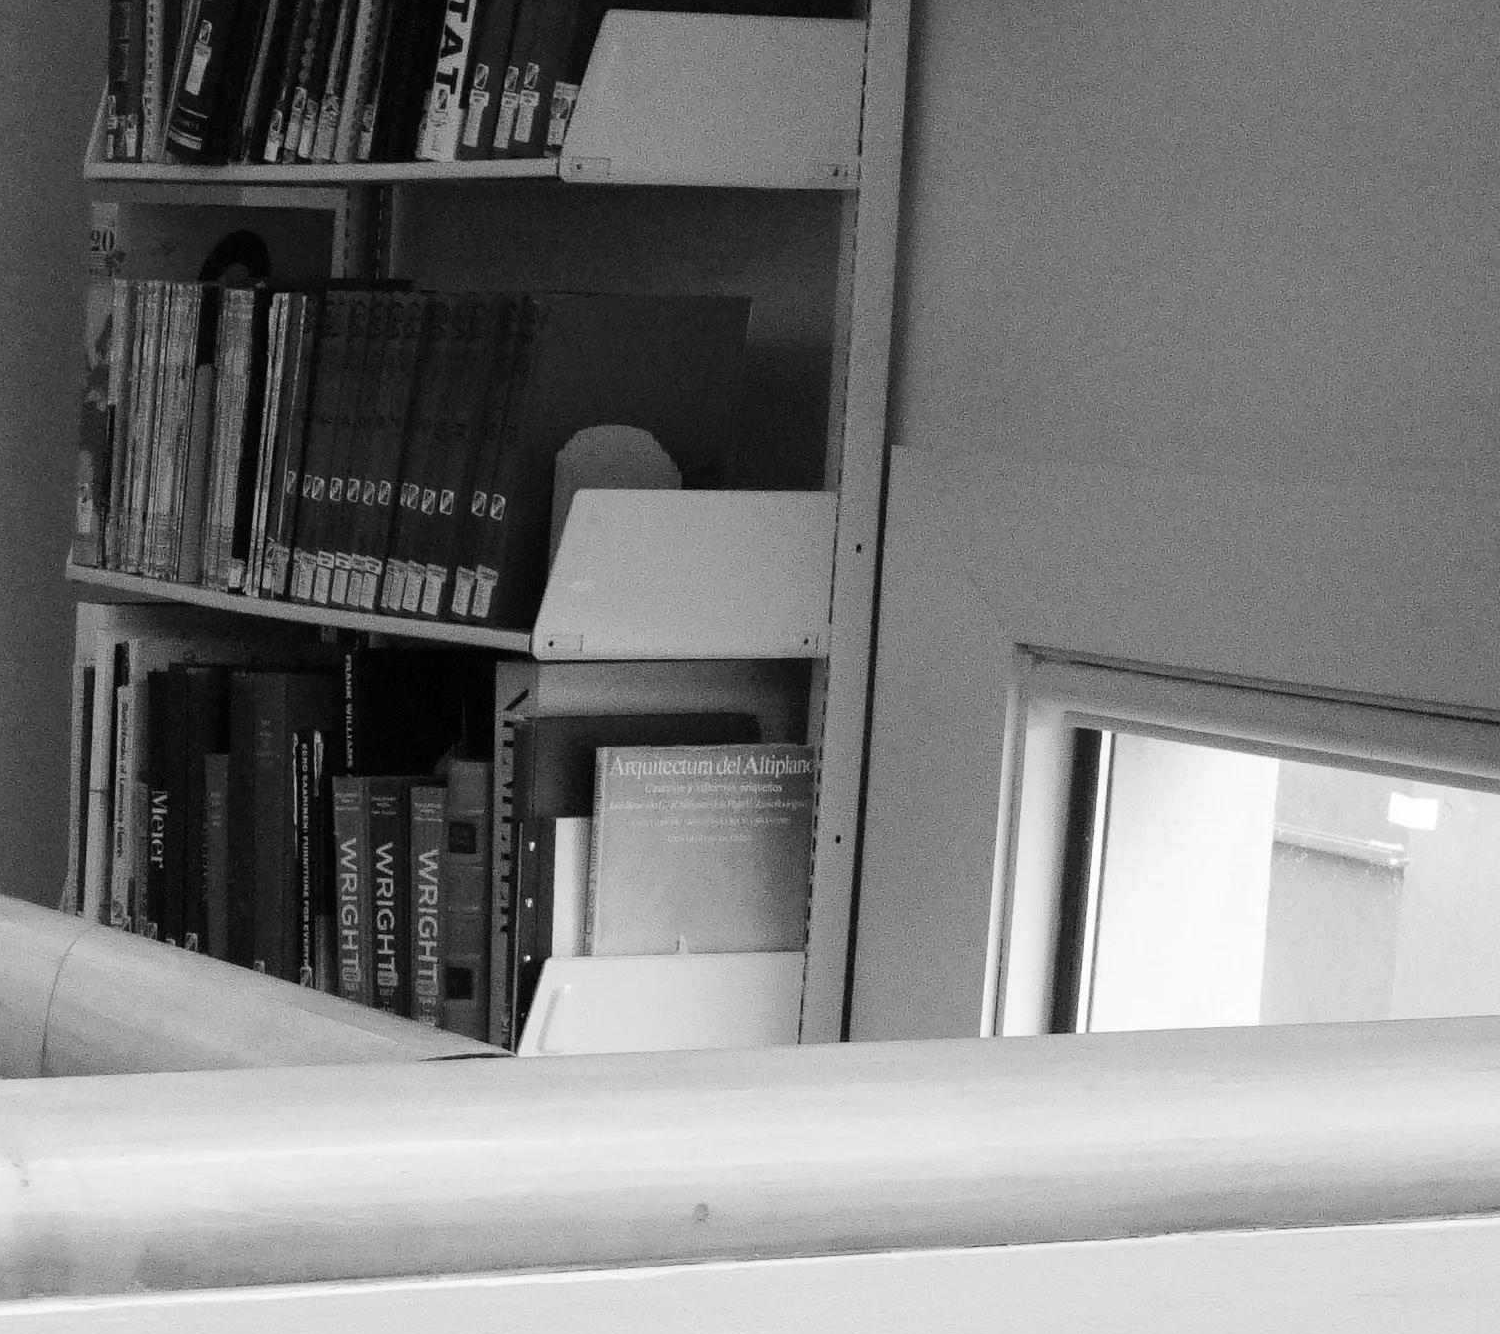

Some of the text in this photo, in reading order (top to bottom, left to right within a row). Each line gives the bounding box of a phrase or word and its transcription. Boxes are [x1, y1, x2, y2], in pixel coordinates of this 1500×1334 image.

[89, 230, 115, 252] 20
[345, 653, 353, 768] FRANK WILLIAMS
[609, 755, 714, 780] Arquitectura
[716, 754, 741, 775] del
[150, 789, 169, 870] Meier
[301, 835, 310, 897] FURNITURE
[340, 837, 359, 972] WRIGHT
[376, 841, 396, 975] WRIGHT
[418, 848, 440, 984] WRIGHT
